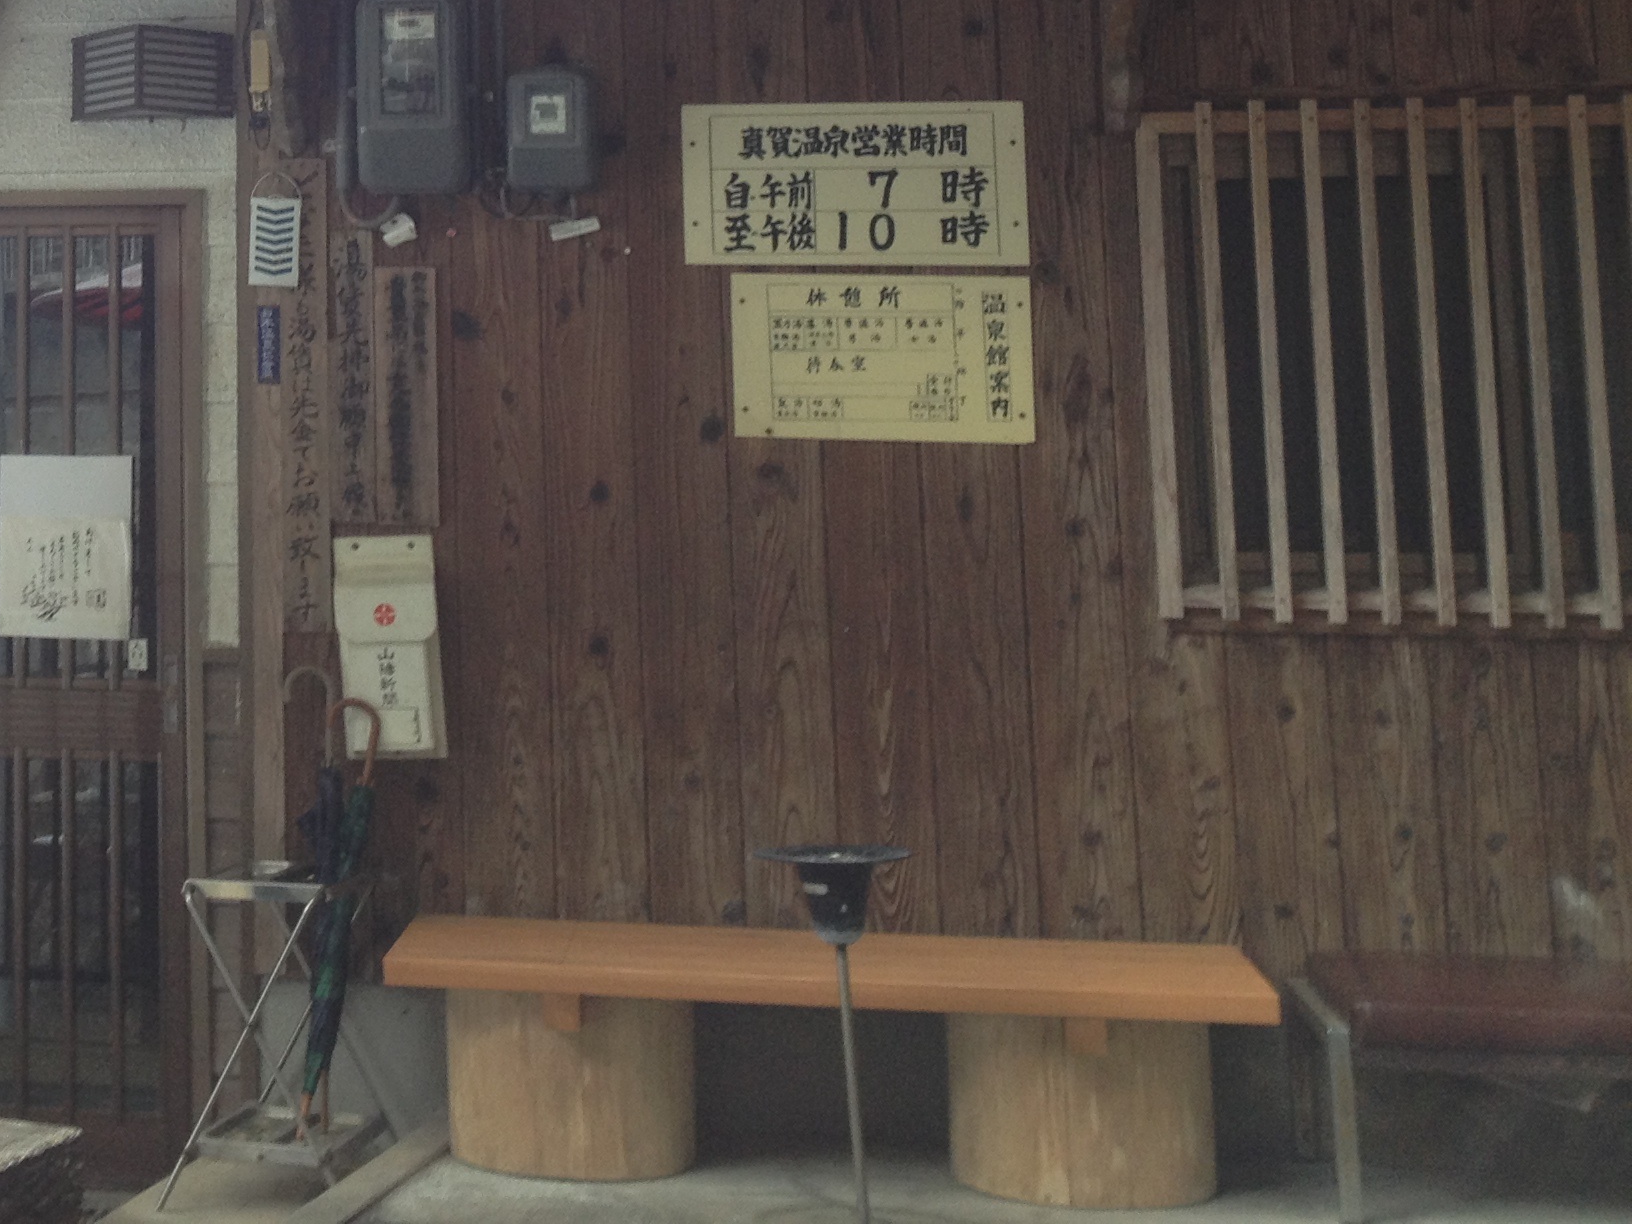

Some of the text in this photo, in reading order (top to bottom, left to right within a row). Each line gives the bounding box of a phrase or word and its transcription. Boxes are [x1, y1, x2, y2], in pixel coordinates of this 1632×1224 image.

[738, 124, 968, 161] 真賀温泉営業時間
[868, 169, 899, 209] 7
[940, 166, 990, 208] 時
[837, 211, 896, 252] 10
[940, 210, 990, 249] 時
[806, 286, 902, 308] 休憩所
[982, 292, 1010, 419] 温泉館案内
